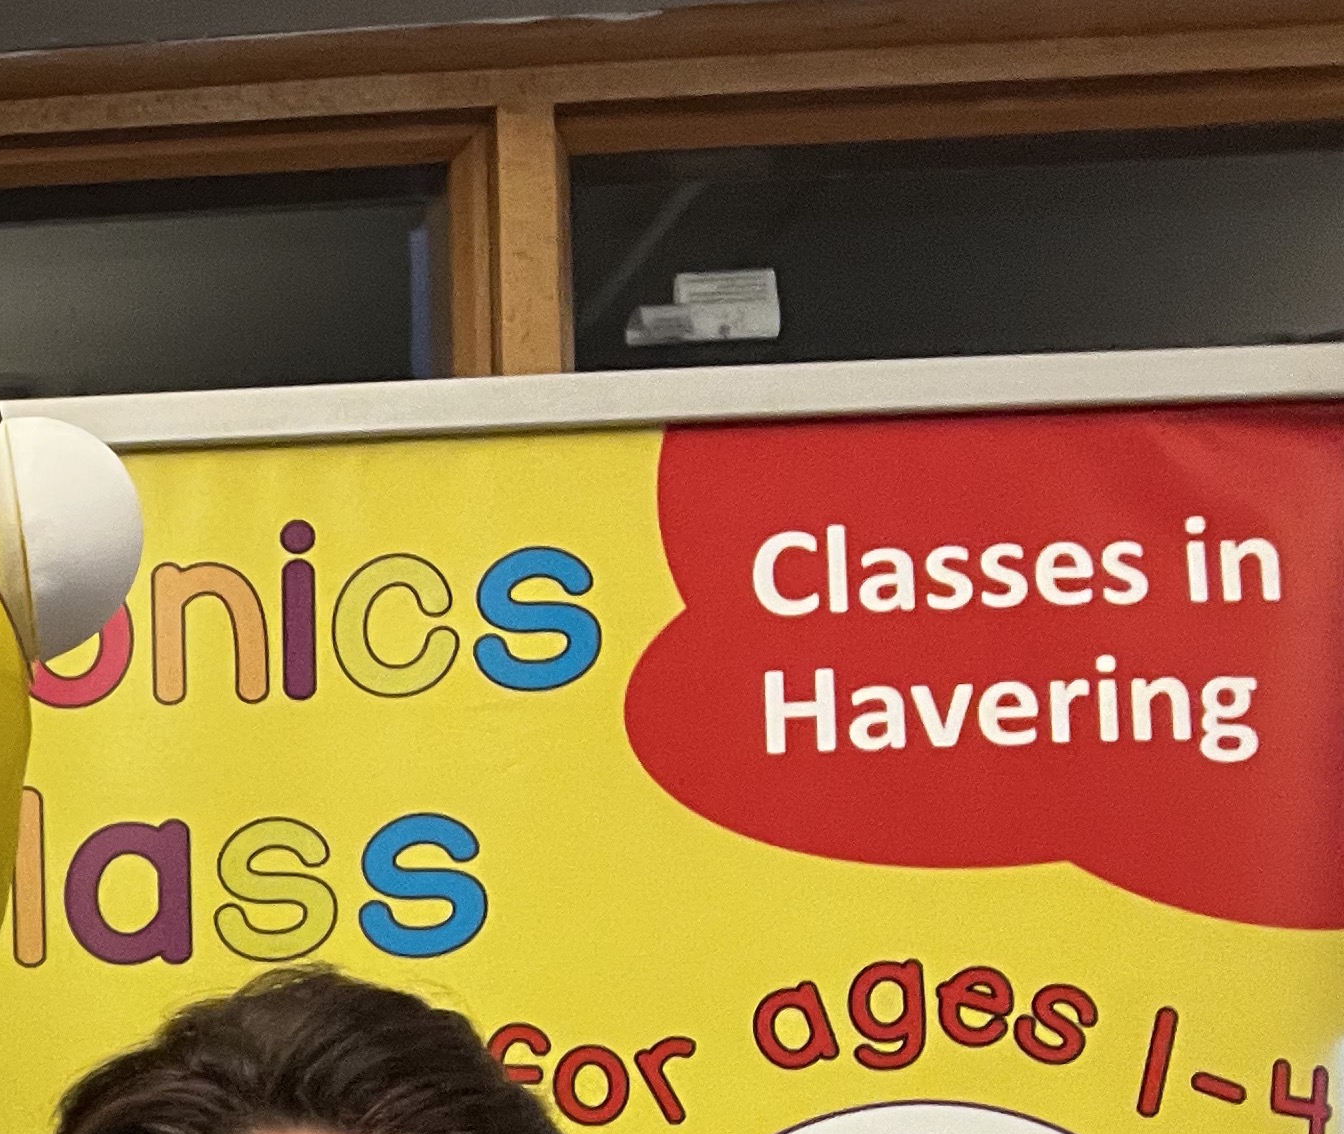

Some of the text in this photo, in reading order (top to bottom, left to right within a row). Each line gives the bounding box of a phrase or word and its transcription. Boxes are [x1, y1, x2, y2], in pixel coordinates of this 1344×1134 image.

[752, 515, 1282, 618] Classes in
[763, 654, 1259, 763] Havering
[752, 957, 1099, 1071] ages
